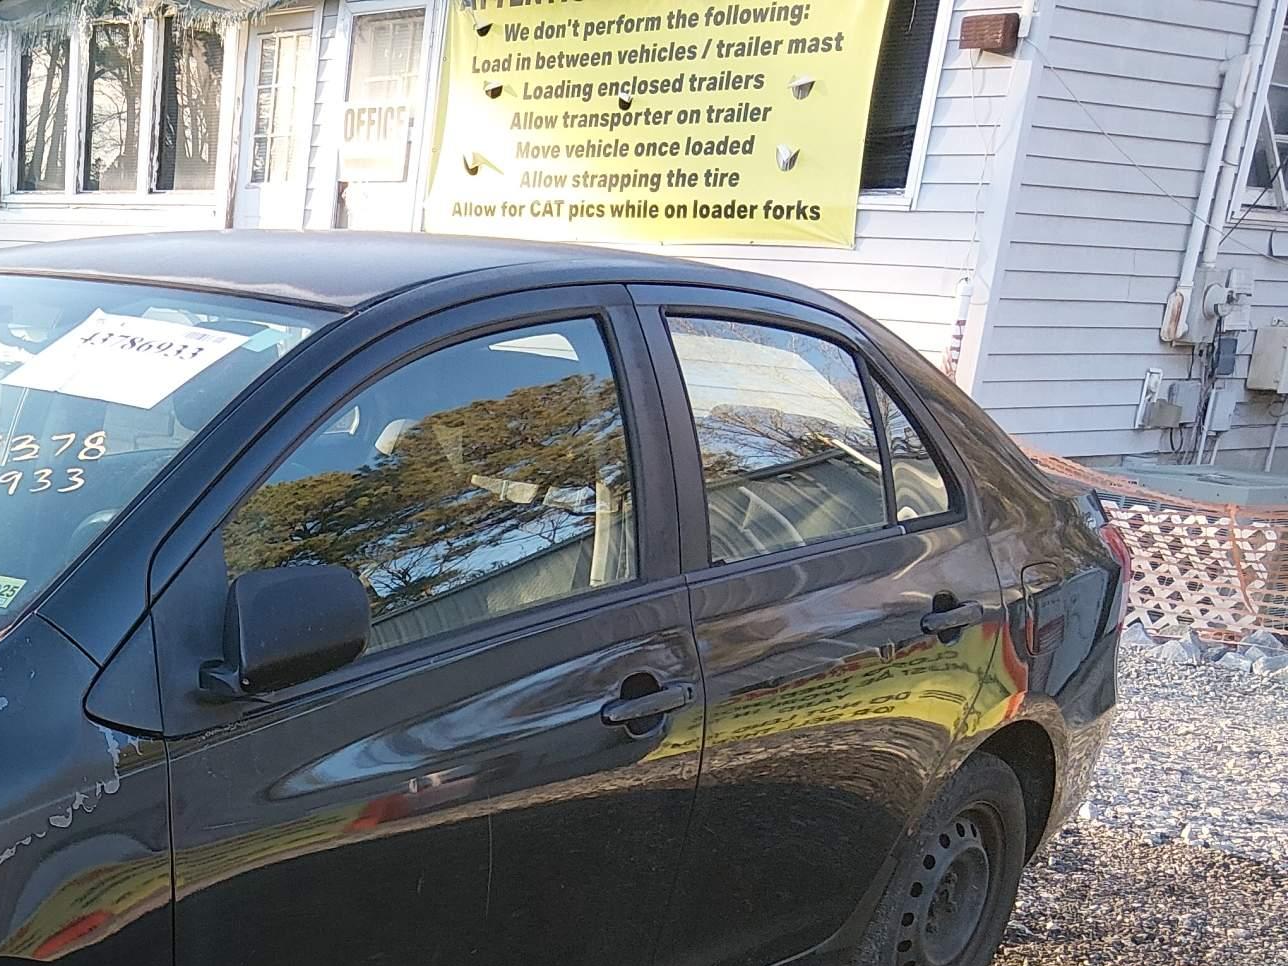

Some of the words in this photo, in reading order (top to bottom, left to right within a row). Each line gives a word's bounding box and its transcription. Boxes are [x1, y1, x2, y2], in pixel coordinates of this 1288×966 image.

[504, 23, 529, 42] We
[534, 19, 579, 40] don't
[583, 14, 661, 40] perform
[667, 9, 699, 29] the
[704, 2, 810, 26] following:
[472, 53, 512, 73] Load
[516, 52, 531, 71] in
[535, 50, 612, 70] between
[617, 43, 697, 65] vehicles
[701, 39, 712, 59] /
[716, 36, 783, 58] trailer
[787, 32, 844, 54] mast
[523, 80, 593, 102] Loading
[598, 75, 685, 95] enclosed
[689, 71, 764, 92] trailers
[344, 106, 406, 142] OFFICE
[510, 112, 558, 130] Allow
[562, 105, 673, 131] transporter
[677, 107, 701, 125] on
[706, 103, 772, 123] trailer
[516, 141, 560, 159] Move
[565, 139, 629, 158] vehicle
[634, 141, 680, 157] once
[685, 135, 755, 156] loaded
[520, 171, 567, 188] Allow
[572, 168, 661, 192] strapping
[667, 168, 698, 188] the
[704, 168, 740, 188] tire
[452, 201, 496, 217] Allow
[502, 201, 525, 217] for
[530, 200, 564, 218] CAT
[569, 200, 605, 222] pics
[610, 199, 659, 219] while
[664, 204, 687, 218] on
[693, 200, 758, 219] loader
[763, 200, 820, 220] forks
[80, 330, 205, 361] 43786933
